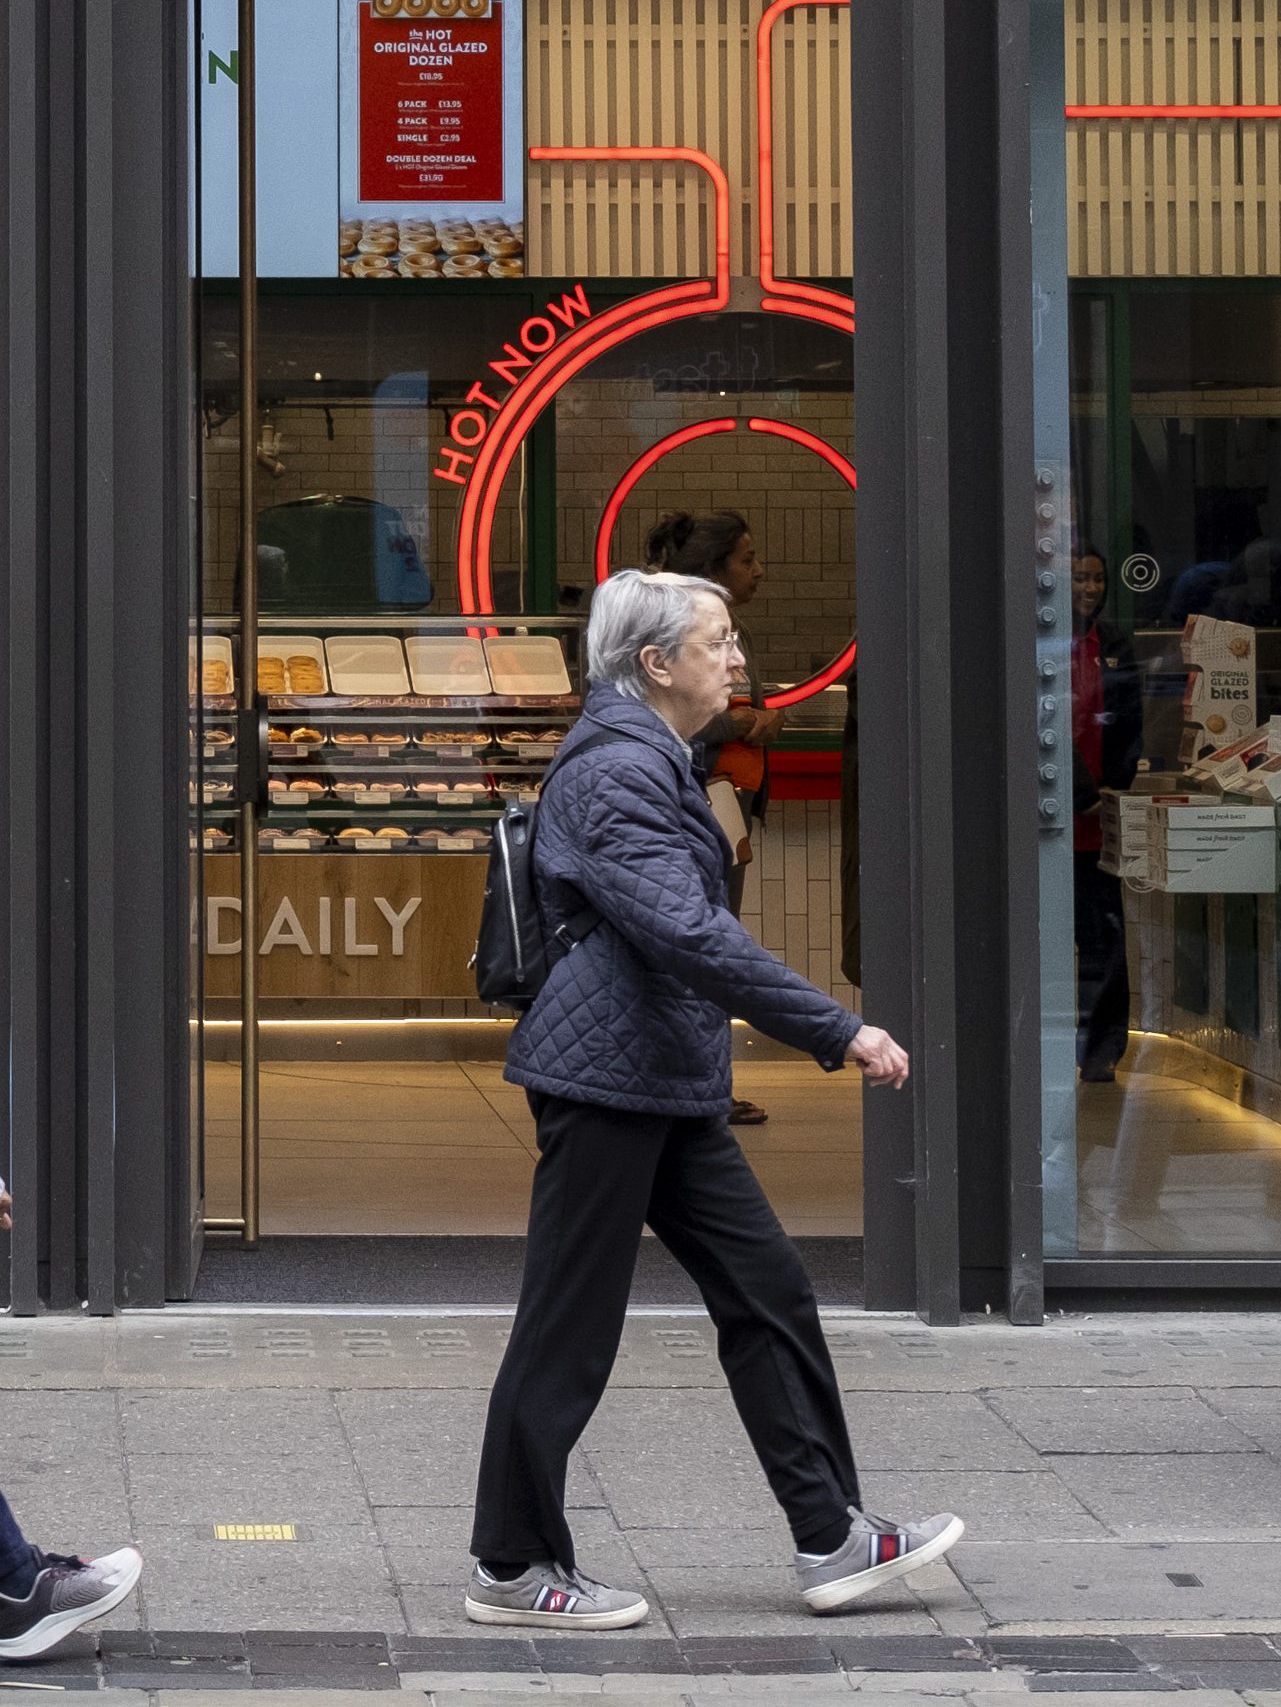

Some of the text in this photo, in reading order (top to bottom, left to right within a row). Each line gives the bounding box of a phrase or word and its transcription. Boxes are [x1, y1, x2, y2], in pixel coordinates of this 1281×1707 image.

[425, 29, 453, 40] HOT
[374, 42, 488, 53] ORIGINAL GLAZED
[409, 55, 453, 66] DOZEN
[404, 100, 427, 108] PACK
[404, 117, 428, 125] PACK
[386, 155, 478, 163] DOUBLE DOZEN DEAL
[432, 282, 592, 485] HOT NOW
[1210, 670, 1249, 679] ORIGINAL
[1210, 678, 1249, 687] GLAZED
[1210, 687, 1249, 700] bites
[206, 896, 422, 957] DAILY
